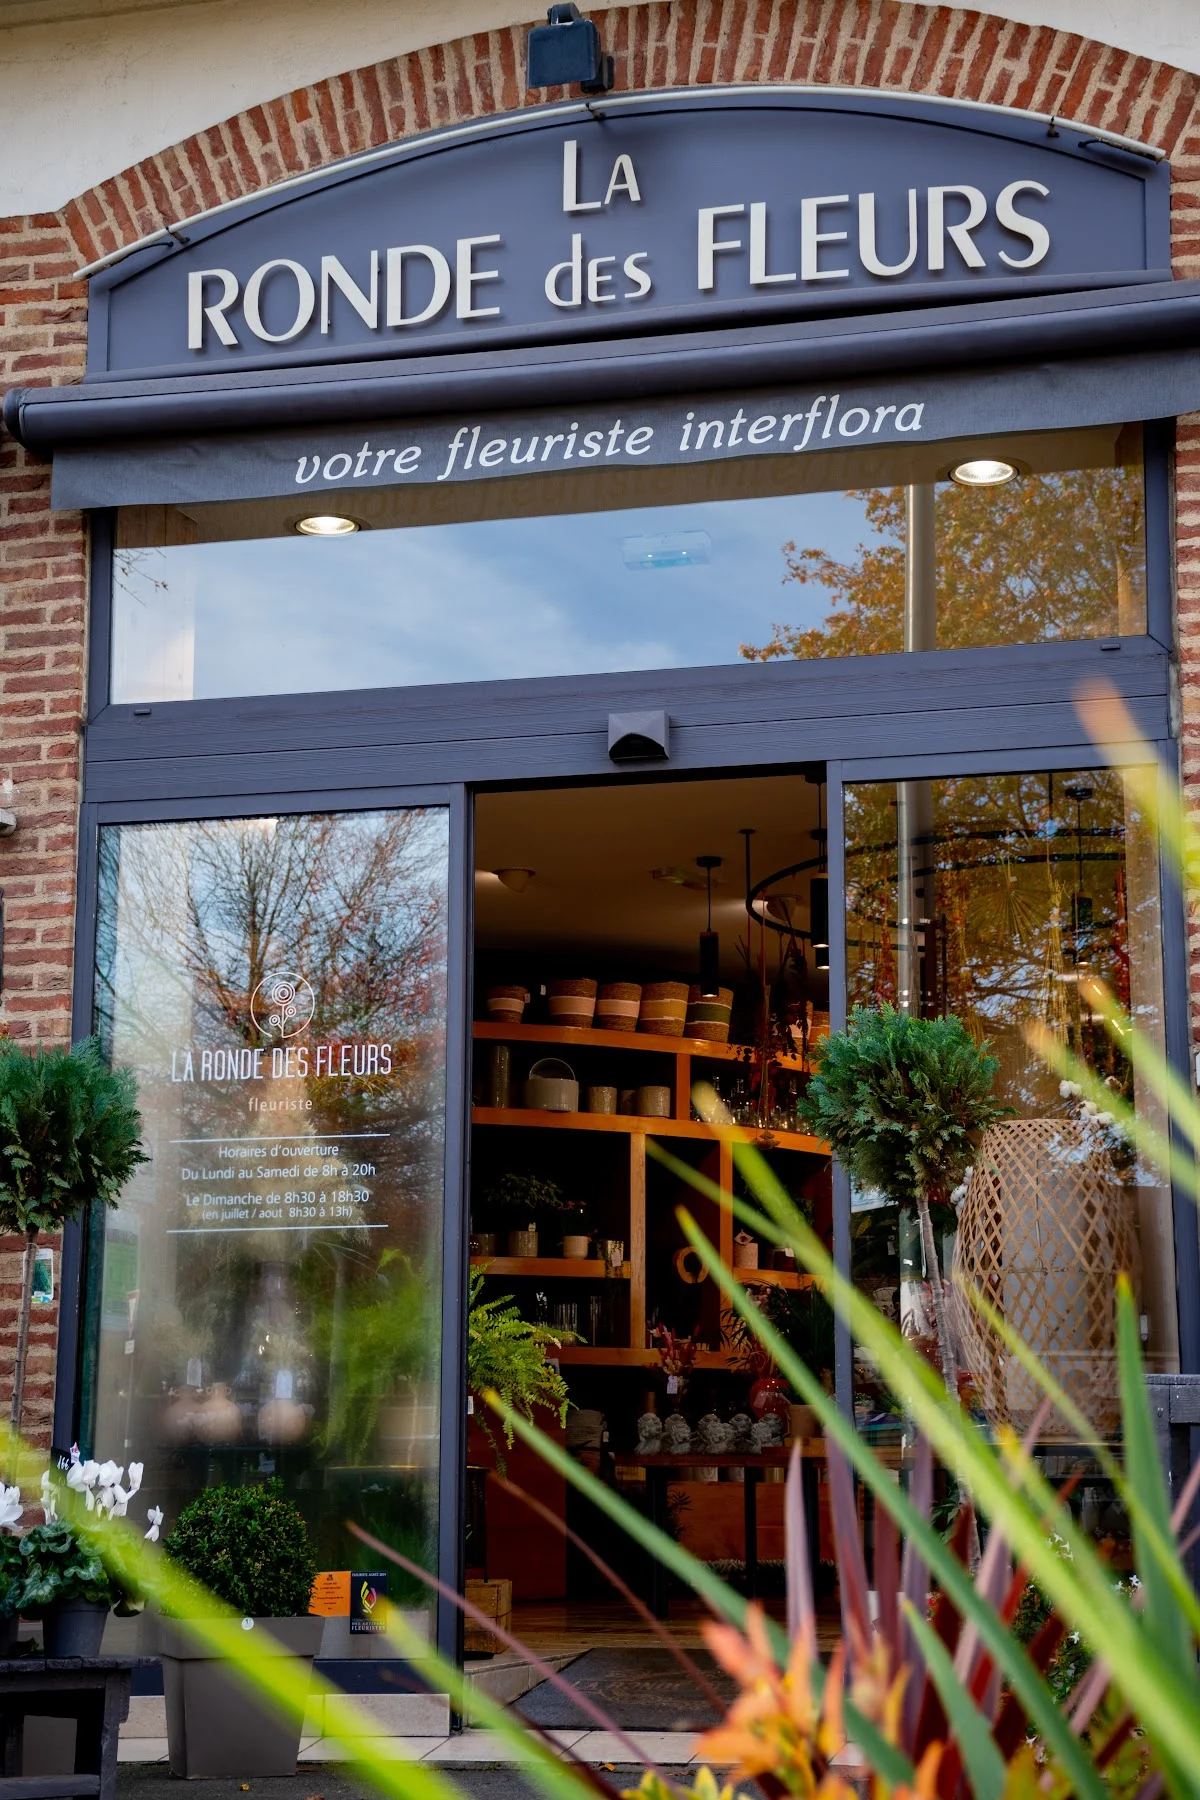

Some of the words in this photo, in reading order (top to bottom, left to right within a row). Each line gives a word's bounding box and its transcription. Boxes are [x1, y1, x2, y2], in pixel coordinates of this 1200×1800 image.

[563, 140, 641, 212] LA
[188, 234, 502, 349] RONDE
[698, 180, 1050, 290] FLEURS
[295, 441, 422, 484] votre
[437, 419, 653, 481] fleuriste
[679, 394, 925, 452] interflora
[171, 1050, 195, 1083] LA
[201, 1048, 265, 1082] RONDE
[272, 1046, 309, 1079] DES
[316, 1043, 392, 1078] FLEURS
[248, 1097, 313, 1113] fleuriste
[218, 1146, 267, 1159] Horaires
[181, 1167, 199, 1180] Du
[202, 1166, 235, 1180] Lundi
[238, 1168, 253, 1179] au
[256, 1164, 300, 1178] Samedi
[303, 1164, 319, 1177] de
[321, 1164, 338, 1177] 8h
[341, 1164, 349, 1176] à
[352, 1163, 376, 1176] 20h
[186, 1193, 200, 1206] Le
[203, 1192, 263, 1206] Dimanche
[266, 1191, 281, 1204] de
[284, 1191, 316, 1204] 8h30
[319, 1190, 327, 1203] à
[331, 1189, 370, 1203] 18h30
[202, 1209, 218, 1221] (en
[220, 1207, 250, 1222] juillet
[259, 1207, 283, 1219] aout
[288, 1206, 316, 1218] 8h30
[319, 1206, 326, 1217] à
[330, 1205, 353, 1218] 13h)
